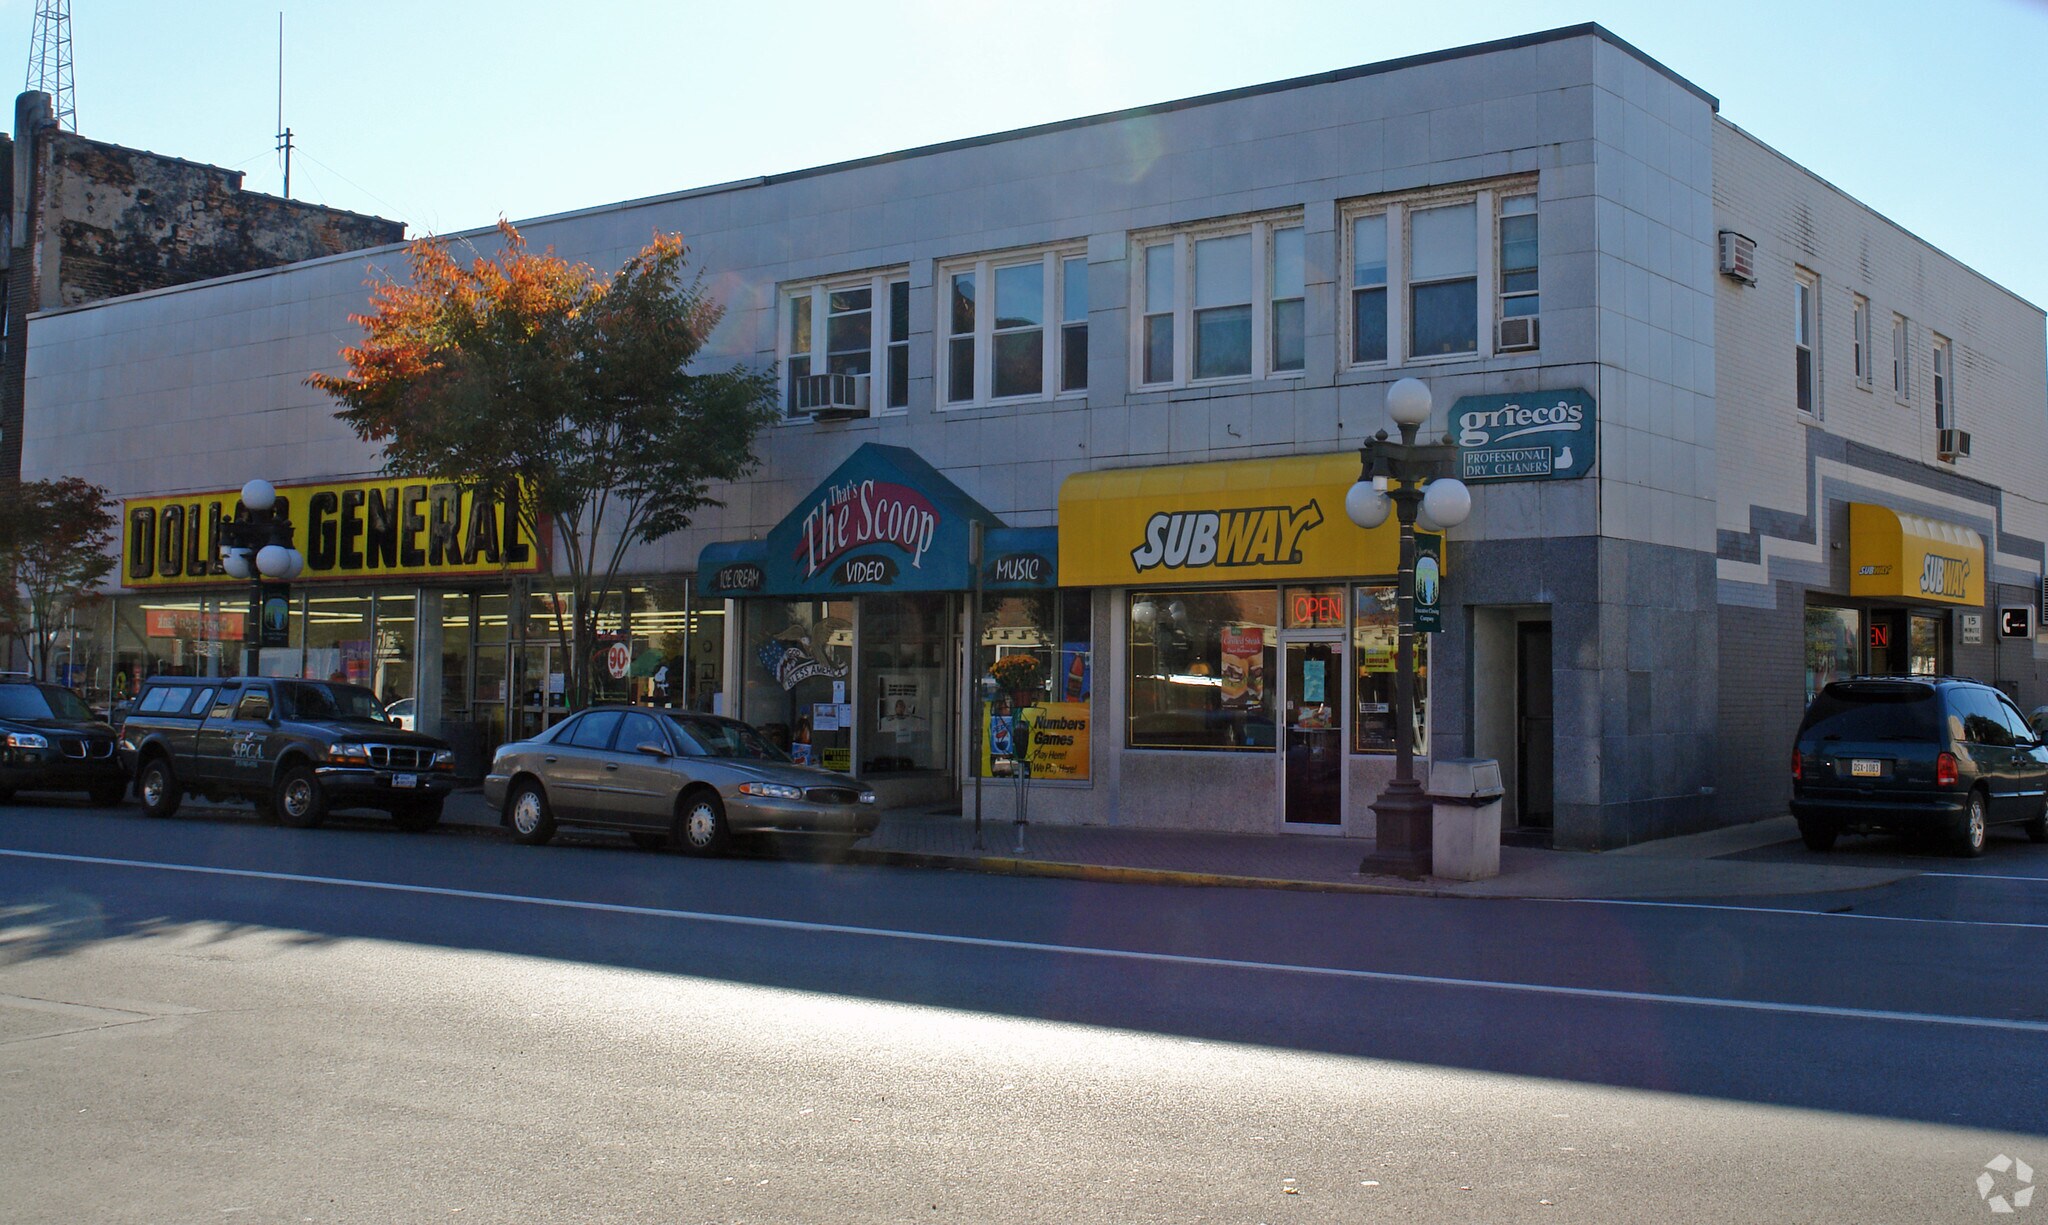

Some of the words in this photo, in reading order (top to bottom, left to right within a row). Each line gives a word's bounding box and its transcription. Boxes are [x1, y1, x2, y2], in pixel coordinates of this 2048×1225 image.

[1458, 401, 1583, 447] grieco's
[1467, 450, 1546, 464] PROFESSIONAL
[1466, 464, 1488, 476] DRY
[1495, 461, 1548, 474] CLEANERS
[829, 479, 857, 506] That's
[130, 496, 289, 577] DOLL
[308, 477, 529, 571] GENERAL
[803, 498, 849, 578] The
[857, 479, 935, 569] Scoop
[1132, 499, 1320, 573] SUBWAY
[720, 570, 732, 588] ICE
[733, 568, 759, 588] CREAM
[846, 561, 884, 582] VIDEO
[996, 558, 1038, 580] MUSIC
[1859, 565, 1891, 575] SUBWAY
[1920, 553, 1970, 598] SUBWAY
[1295, 597, 1341, 622] OPEN
[1968, 617, 1976, 625] 15
[788, 665, 810, 688] BLESS
[1034, 716, 1085, 730] Numbers
[1034, 731, 1074, 745] Games
